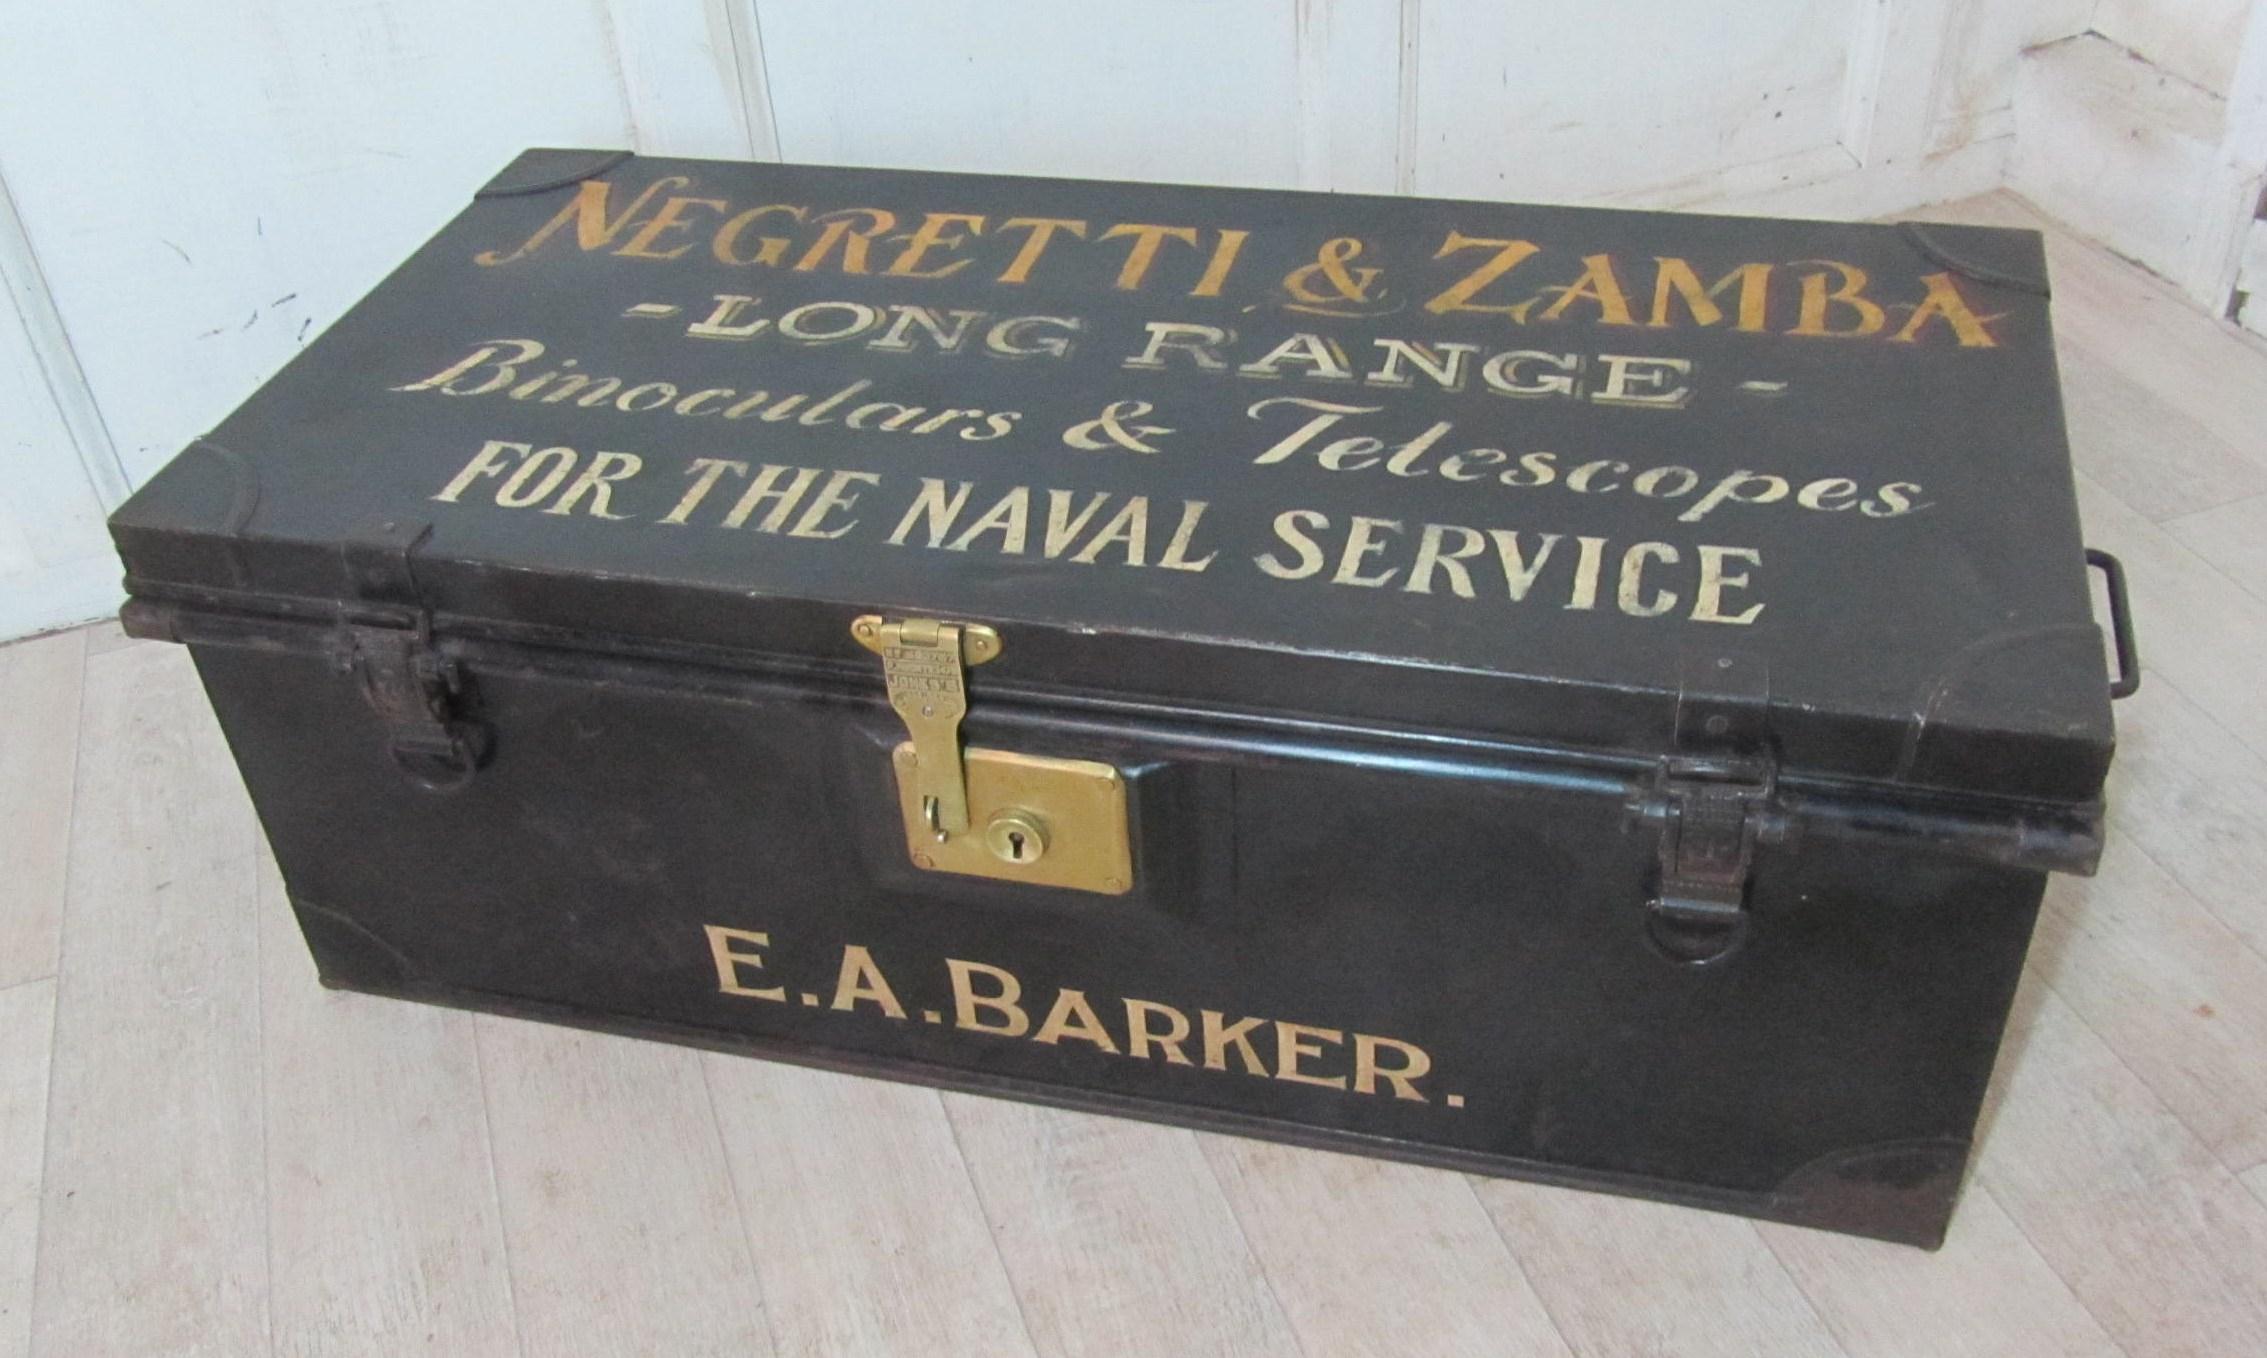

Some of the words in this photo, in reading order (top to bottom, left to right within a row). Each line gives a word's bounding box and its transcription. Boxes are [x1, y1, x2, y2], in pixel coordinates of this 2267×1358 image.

[475, 175, 1250, 299] NEGRETTI
[1281, 237, 1407, 317] &
[1424, 231, 2012, 350] ZAMBA
[684, 293, 1085, 359] LONG
[1120, 321, 1694, 408] RANGE
[390, 338, 1024, 441] Binoculars
[1061, 399, 1176, 456] &
[1244, 396, 1930, 522] Telescopes
[430, 440, 642, 522] FOR
[655, 458, 882, 542] THE
[884, 477, 1220, 574] NAVAL
[1253, 508, 1767, 627] SERVICE
